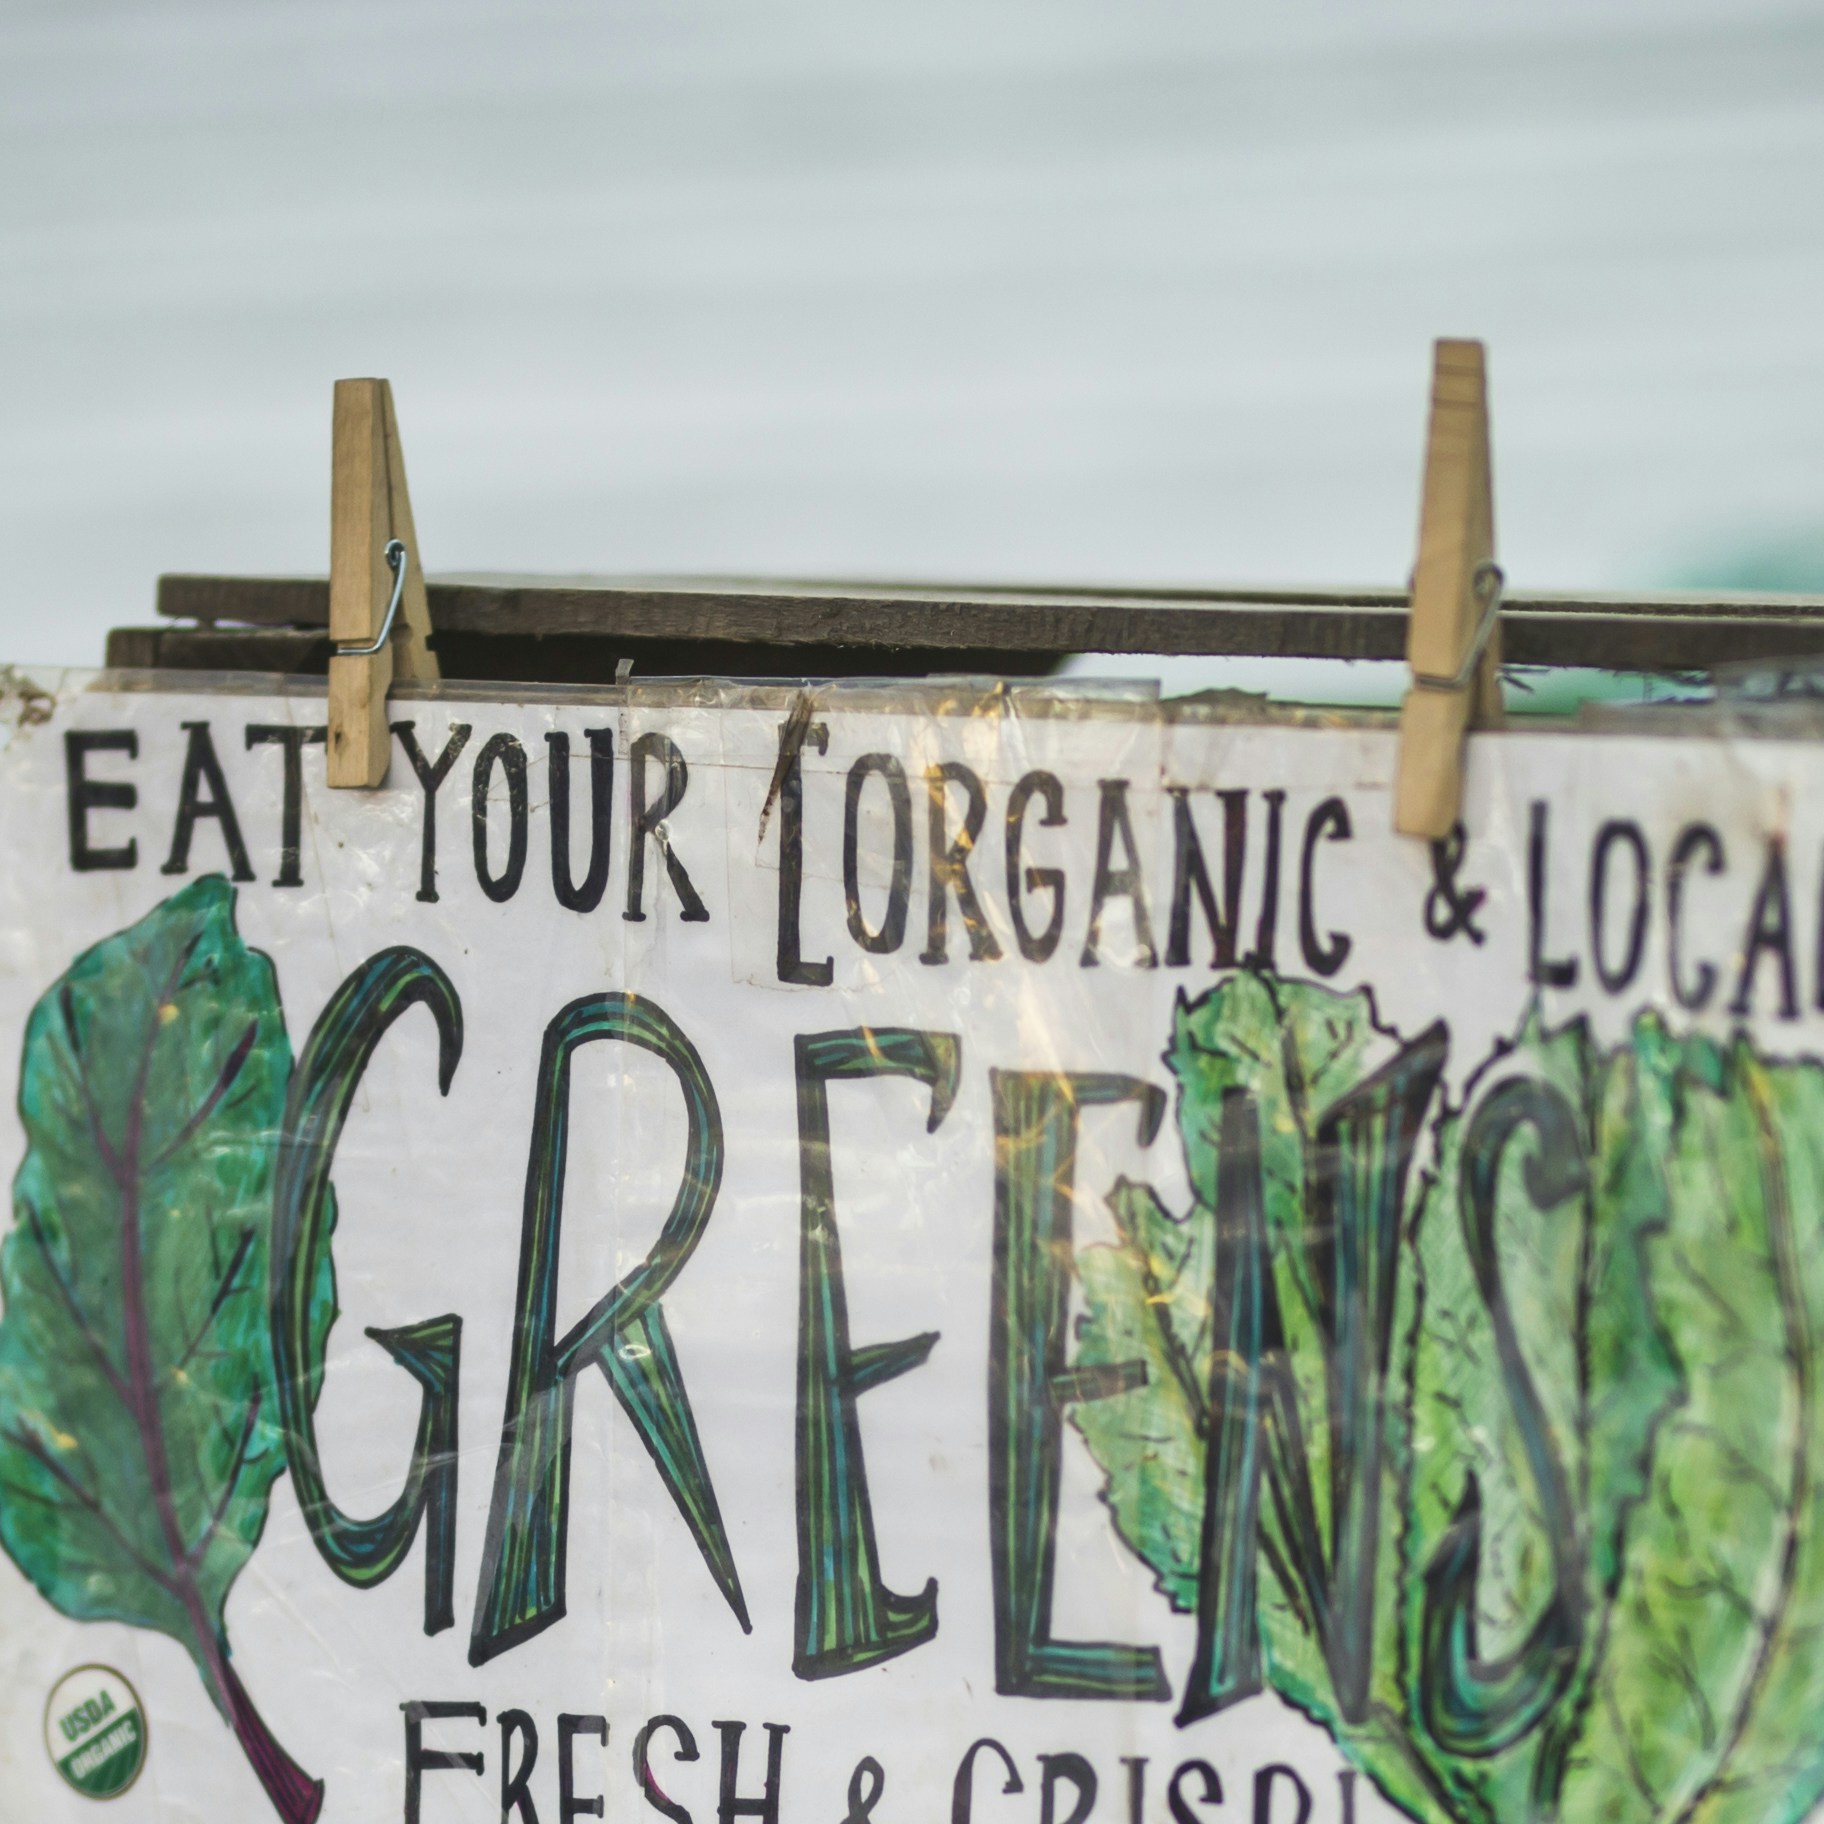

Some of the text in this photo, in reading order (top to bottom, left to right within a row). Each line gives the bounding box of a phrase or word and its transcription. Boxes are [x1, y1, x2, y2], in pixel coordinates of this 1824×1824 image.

[64, 720, 330, 888] EAT
[389, 718, 710, 923] YOUR
[776, 721, 1354, 987] [ORGANIC
[1424, 820, 1487, 945] &
[269, 944, 1586, 1760] GREENS
[58, 1689, 117, 1743] USDA
[69, 1719, 138, 1780] ORGANIC
